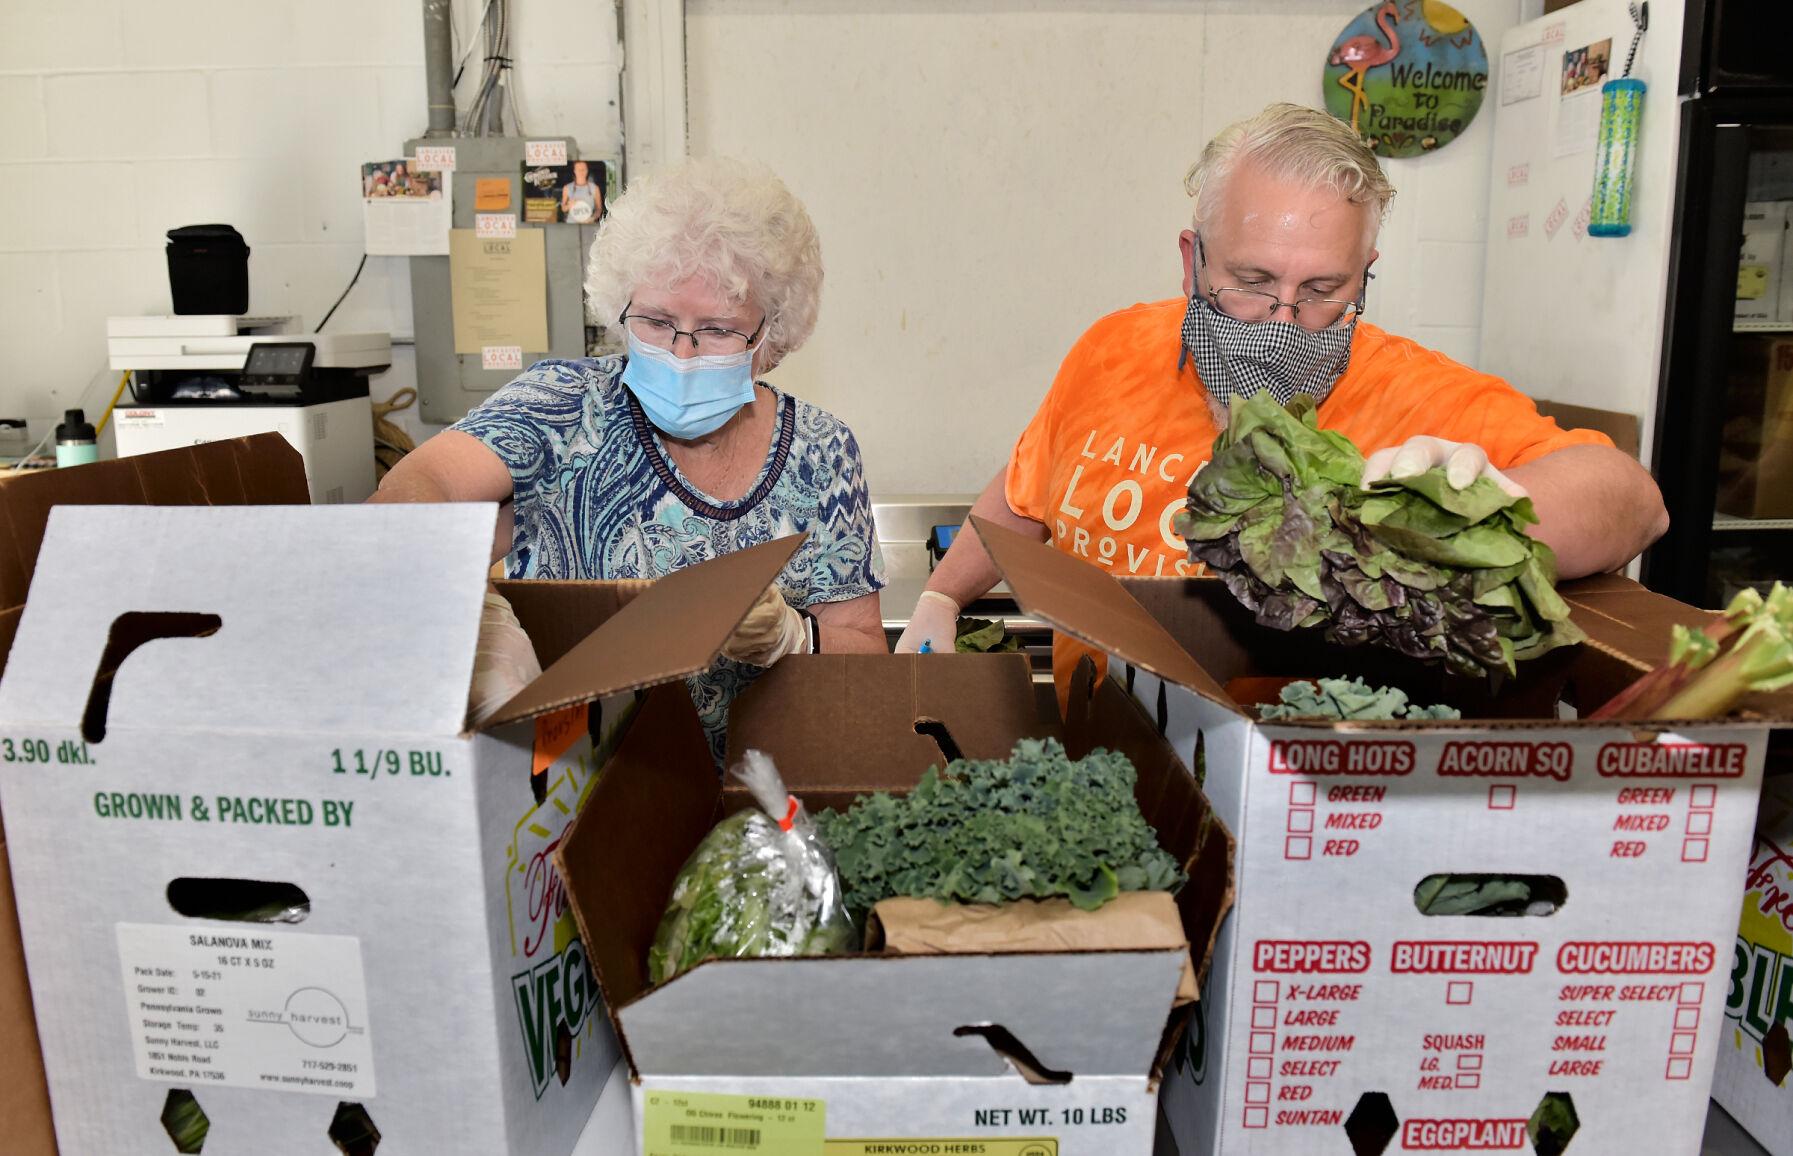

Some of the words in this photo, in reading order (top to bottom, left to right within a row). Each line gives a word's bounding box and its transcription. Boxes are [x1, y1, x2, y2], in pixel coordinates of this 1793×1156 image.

[1391, 62, 1484, 91] Welcome
[1368, 104, 1462, 132] Paradise
[417, 154, 454, 163] LOCAL
[477, 222, 514, 230] LOCAL
[484, 353, 520, 361] LOCAL
[1059, 465, 1188, 552] LOC
[2, 738, 50, 763] 3.90
[57, 741, 96, 765] dkl.
[1270, 741, 1343, 773] LONG
[1346, 741, 1415, 774] HOTS
[332, 748, 346, 773] 1
[354, 749, 401, 779] 1/9
[409, 751, 451, 777] BU.
[1437, 742, 1531, 776] ACORN
[1533, 743, 1573, 780] SQ
[1597, 743, 1747, 778] CUBANELLE
[1327, 785, 1386, 802] GREEN
[1617, 788, 1675, 804] GREEN
[94, 792, 182, 821] GROWN
[191, 795, 210, 821] &
[217, 797, 313, 826] PACKED
[323, 800, 354, 827] BY
[1325, 813, 1383, 829] MIXED
[1613, 815, 1670, 831] MIXED
[1323, 839, 1360, 856] RED
[1609, 840, 1646, 858] RED
[189, 934, 248, 949] SALANOVA
[251, 938, 273, 950] MIX
[217, 956, 229, 966] 16
[231, 957, 242, 967] CT
[244, 957, 251, 967] X
[1253, 940, 1370, 973] PEPPERS
[1391, 941, 1538, 974] BUTTERNUT
[1557, 942, 1716, 975] CUCUMBERS
[1286, 985, 1362, 1001] X-LARGE
[1558, 985, 1615, 1001] SUPER
[1618, 985, 1680, 1001] SELECT
[140, 1002, 194, 1015] Pennsylvania
[195, 1005, 222, 1015] Grown
[248, 1009, 283, 1021] sunny
[291, 1012, 342, 1026] harvest
[512, 940, 600, 1100] VEG
[1283, 1010, 1340, 1026] LARGE
[1555, 1010, 1616, 1026] SELECT
[1281, 1036, 1355, 1051] MEDIUM
[1423, 1034, 1485, 1052] SQUASH
[1552, 1036, 1606, 1051] SMALL
[1280, 1061, 1341, 1076] SELECT
[1420, 1057, 1440, 1071] LG.
[1548, 1060, 1603, 1076] LARGE
[1417, 1076, 1453, 1090] MED.
[1277, 1085, 1313, 1101] RED
[748, 1099, 782, 1111] 94888
[803, 1101, 816, 1112] 12
[974, 1108, 1012, 1126] NET
[1018, 1108, 1053, 1125] WT.
[1061, 1108, 1084, 1125] 10
[1090, 1107, 1127, 1125] LBS
[1275, 1110, 1343, 1126] SUNTAN
[1402, 1119, 1528, 1150] EGGPLANT
[864, 1144, 941, 1154] KIRKWOOD
[944, 1144, 986, 1154] HERBS
